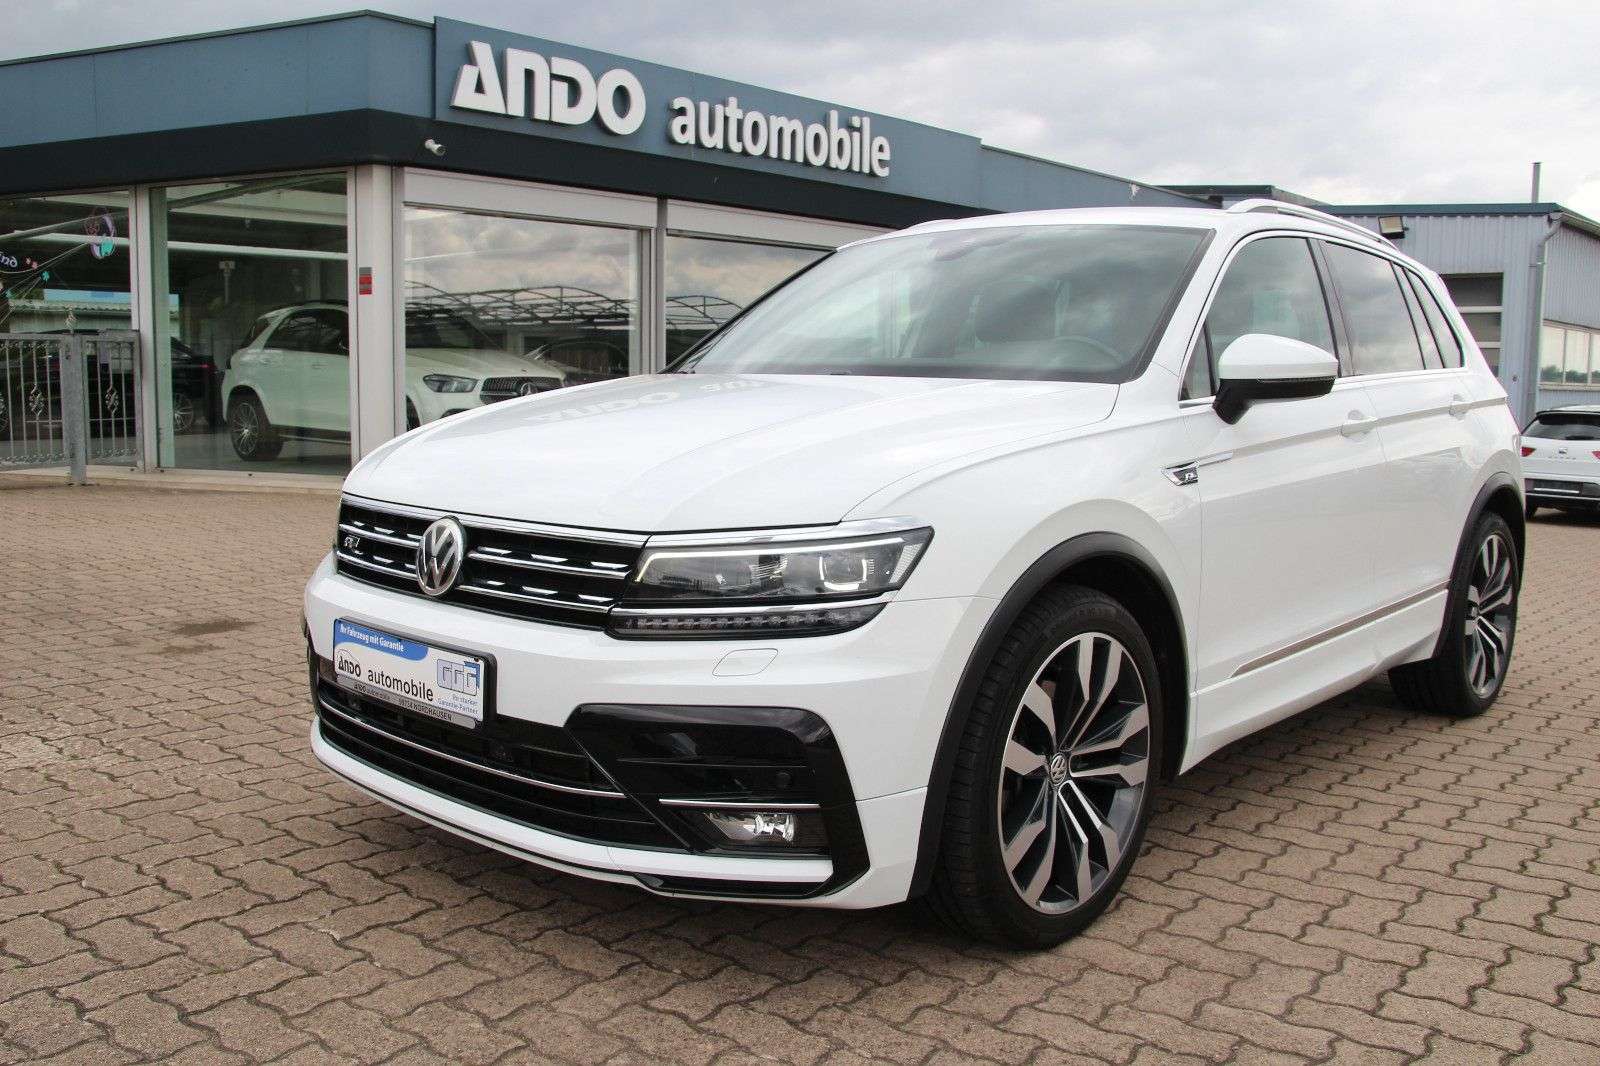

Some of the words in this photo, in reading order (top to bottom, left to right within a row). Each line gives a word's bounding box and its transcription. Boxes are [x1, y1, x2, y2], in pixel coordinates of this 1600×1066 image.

[452, 40, 646, 135] ANDO
[669, 96, 891, 177] automobile
[369, 634, 379, 646] mit
[379, 637, 405, 652] Garantie
[338, 656, 361, 678] ANDO
[367, 669, 434, 702] automobile
